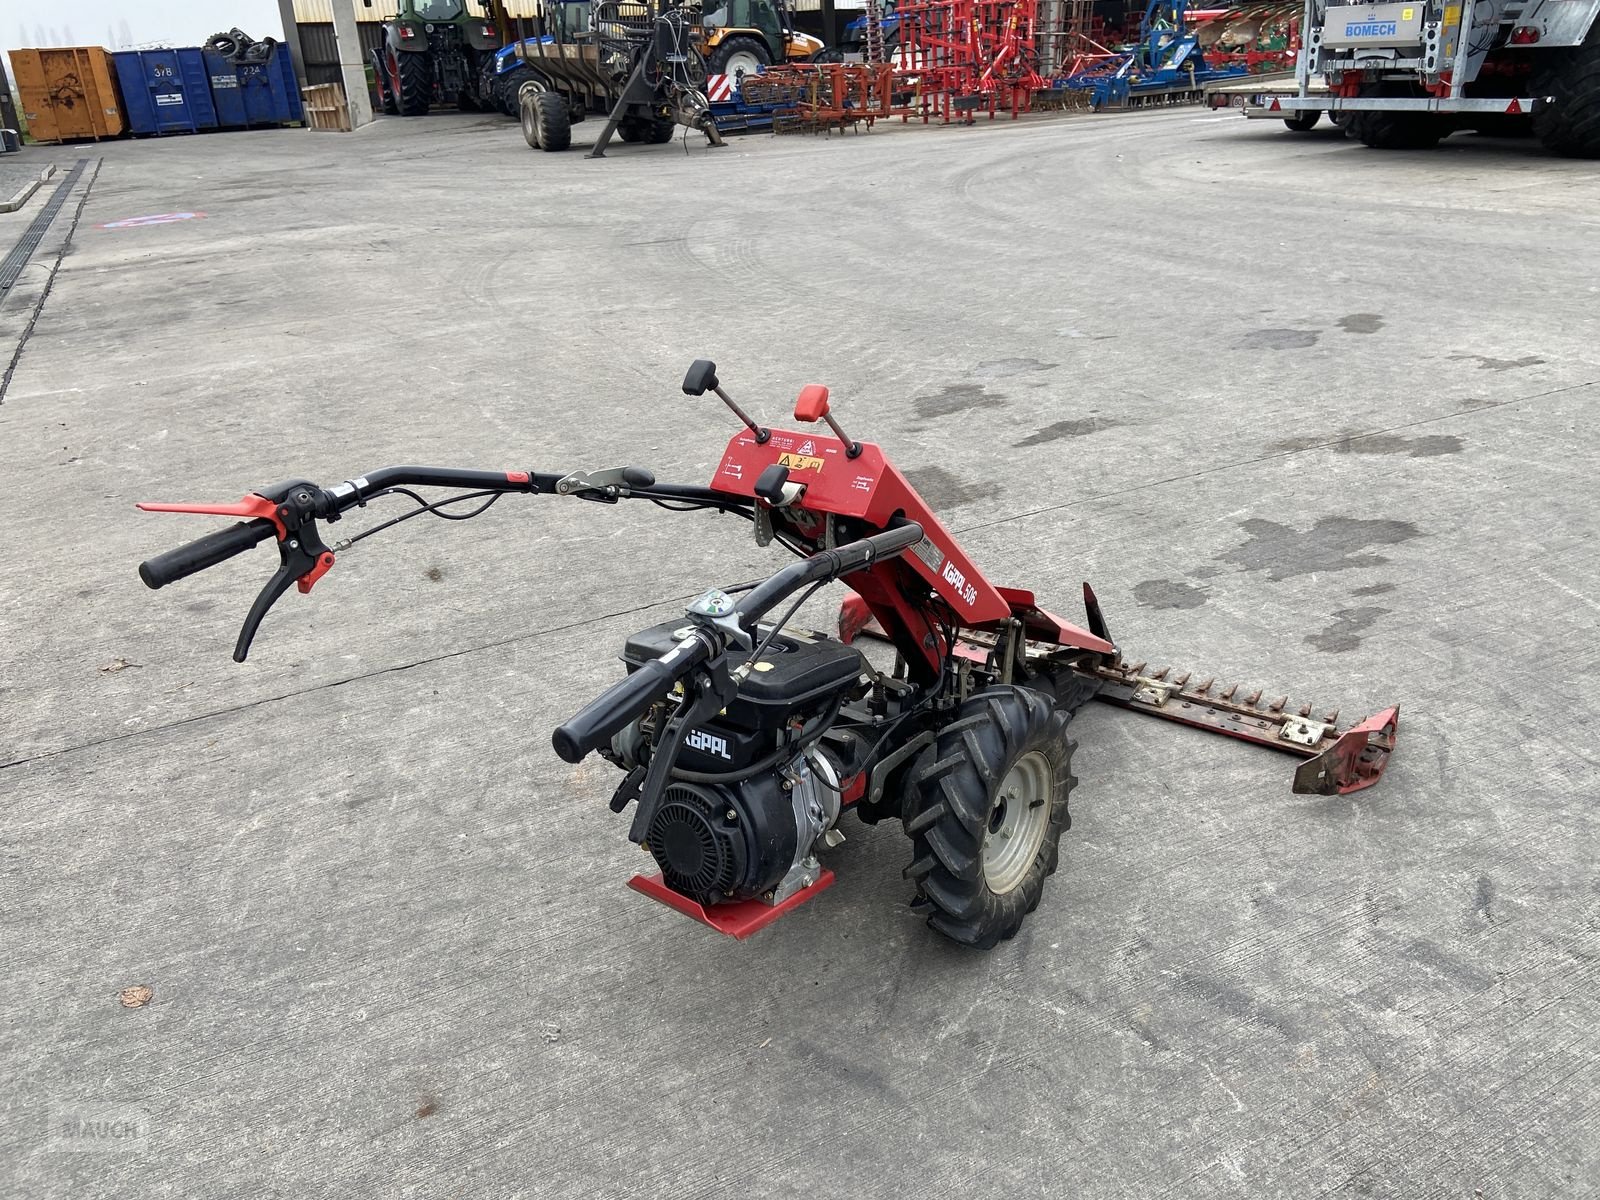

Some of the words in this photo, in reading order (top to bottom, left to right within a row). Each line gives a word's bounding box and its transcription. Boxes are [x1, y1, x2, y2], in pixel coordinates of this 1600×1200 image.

[1345, 24, 1396, 37] BOMECH
[243, 66, 261, 75] 224
[942, 560, 966, 596] KÖPPL
[962, 583, 978, 606] 506
